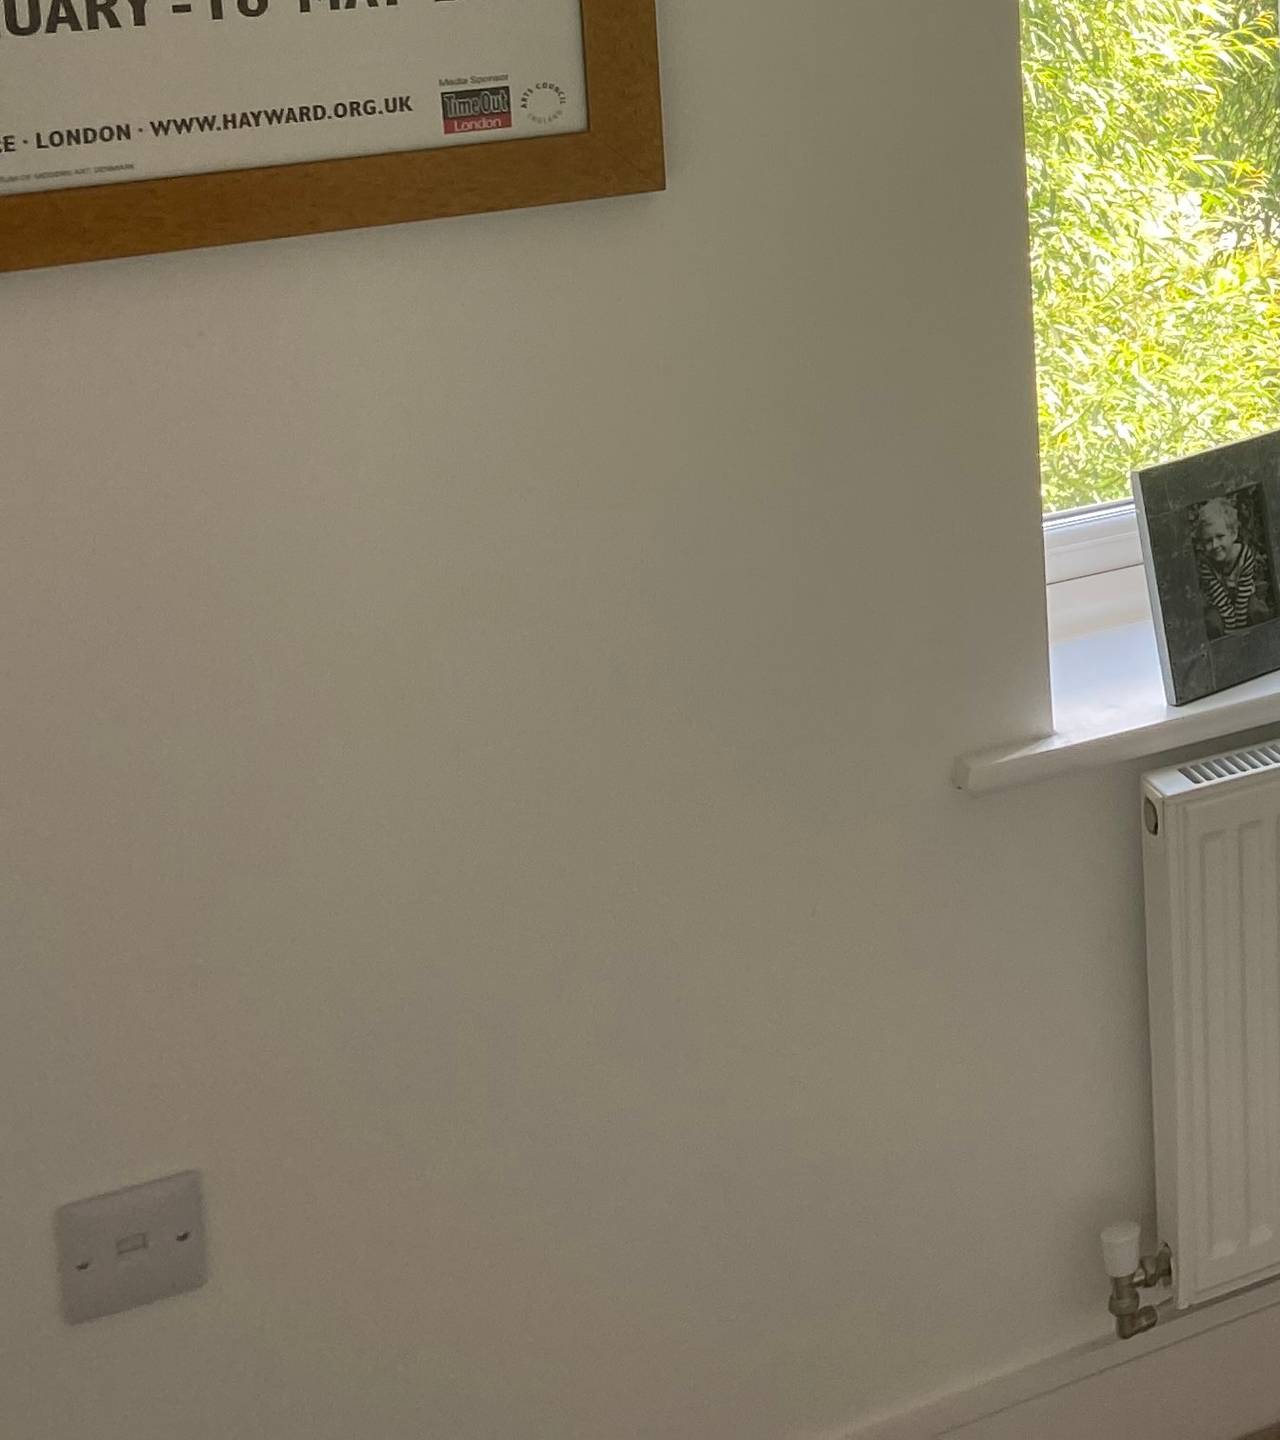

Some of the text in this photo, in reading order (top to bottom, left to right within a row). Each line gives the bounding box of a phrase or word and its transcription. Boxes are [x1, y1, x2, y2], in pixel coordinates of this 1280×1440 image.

[36, 123, 131, 149] LONDON
[150, 96, 413, 137] WWW.HAYWARD.ORG.UK
[454, 118, 501, 132] London
